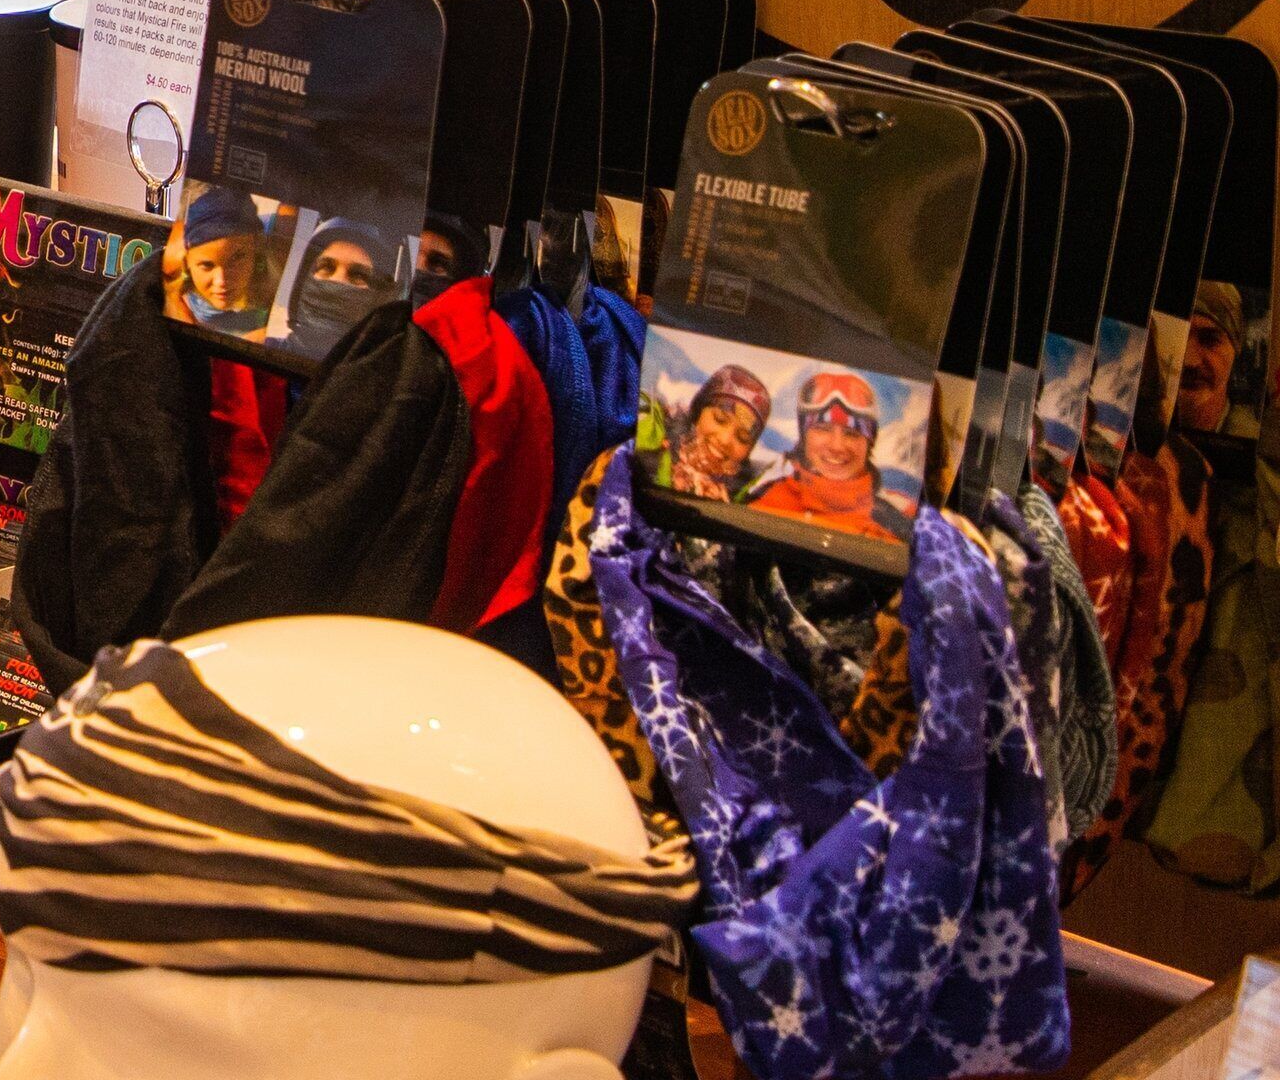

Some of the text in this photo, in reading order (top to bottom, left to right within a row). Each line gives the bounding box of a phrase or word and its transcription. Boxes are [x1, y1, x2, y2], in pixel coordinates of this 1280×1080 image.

[96, 3, 203, 35] colours that Mystical Fire will
[148, 0, 167, 12] back
[168, 4, 186, 17] and
[119, 23, 164, 42] use packs
[93, 30, 195, 66] 60-120 dependent
[246, 48, 312, 75] AUSTRALIAN
[146, 73, 192, 95] $4.50 each
[214, 56, 307, 96] MERINO WOOL
[695, 172, 811, 214] FLEXIBLE TUBE
[16, 352, 29, 361] AN
[10, 362, 61, 383] SIMPLY THROW
[5, 397, 27, 410] READ
[28, 404, 60, 420] SAFETY
[36, 417, 48, 428] DO
[19, 698, 45, 712] CHILDREN
